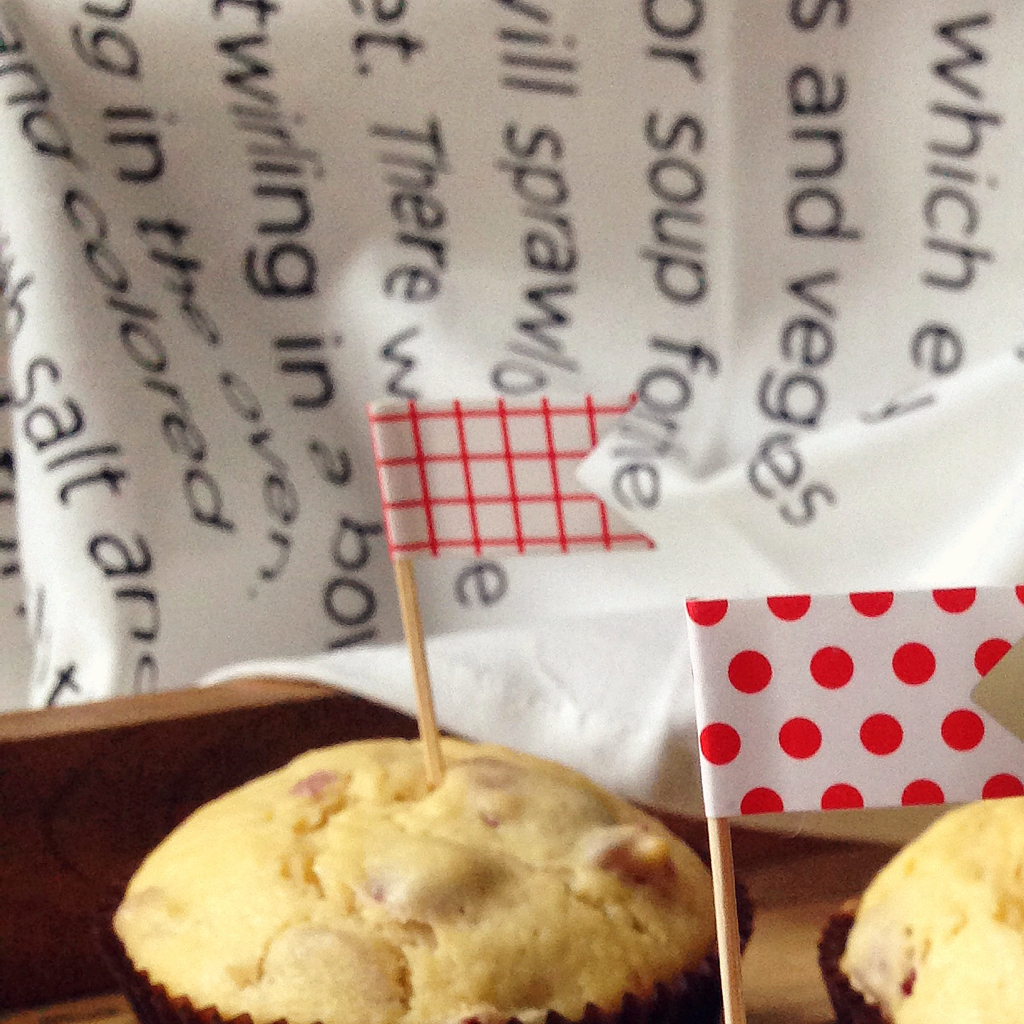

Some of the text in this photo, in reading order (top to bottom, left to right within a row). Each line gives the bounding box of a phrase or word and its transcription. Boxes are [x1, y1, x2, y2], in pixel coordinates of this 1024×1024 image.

[102, 105, 180, 184] in
[366, 114, 450, 302] There
[638, 109, 708, 306] soup
[784, 64, 861, 242] and
[918, 11, 1003, 294] which
[24, 356, 126, 505] salt
[62, 187, 236, 534] colored
[273, 332, 347, 409] in
[745, 270, 838, 528] veges
[308, 438, 353, 487] a
